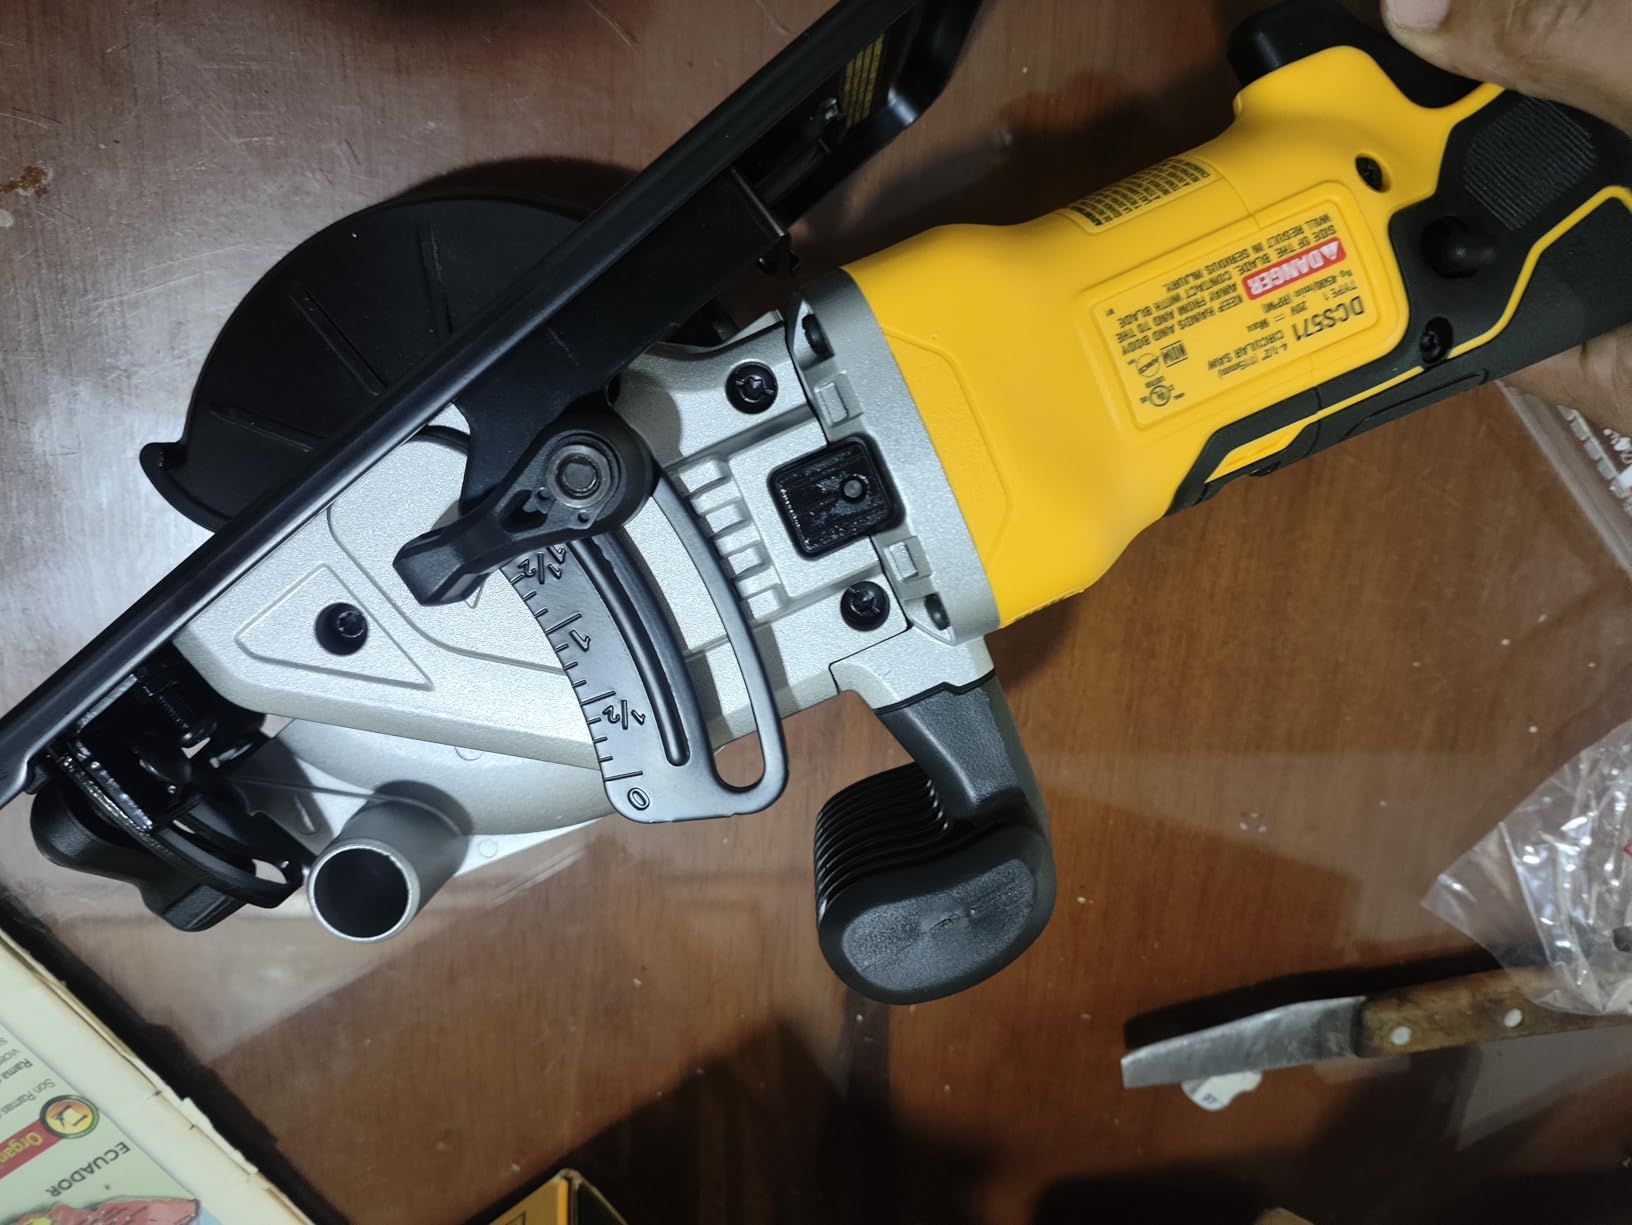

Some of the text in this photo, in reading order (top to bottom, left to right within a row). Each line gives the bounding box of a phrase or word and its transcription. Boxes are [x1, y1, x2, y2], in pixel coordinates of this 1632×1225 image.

[1305, 212, 1329, 230] WILL
[1313, 223, 1335, 242] SIDE
[1266, 224, 1303, 248] RESULT
[1298, 235, 1310, 248] OF
[1251, 242, 1263, 255] IN
[1275, 241, 1294, 258] THE
[1205, 247, 1249, 275] SERIOUS
[1248, 248, 1322, 296] DANGER
[1183, 268, 1232, 299] CONTACT
[1116, 281, 1237, 343] AWAY FROM AND TO THE
[1153, 291, 1183, 312] WITH
[1117, 305, 1151, 328] BLADE
[1122, 293, 1242, 355] KEEP HANDS AND BODY
[1292, 294, 1363, 342] DCS571
[1206, 329, 1283, 371] CIRCULAR SAW
[569, 629, 592, 652] 1
[602, 699, 646, 730] 1/2
[1, 1058, 33, 1080] Rama
[32, 1077, 56, 1096] Son
[45, 1141, 131, 1198] ECUADOR
